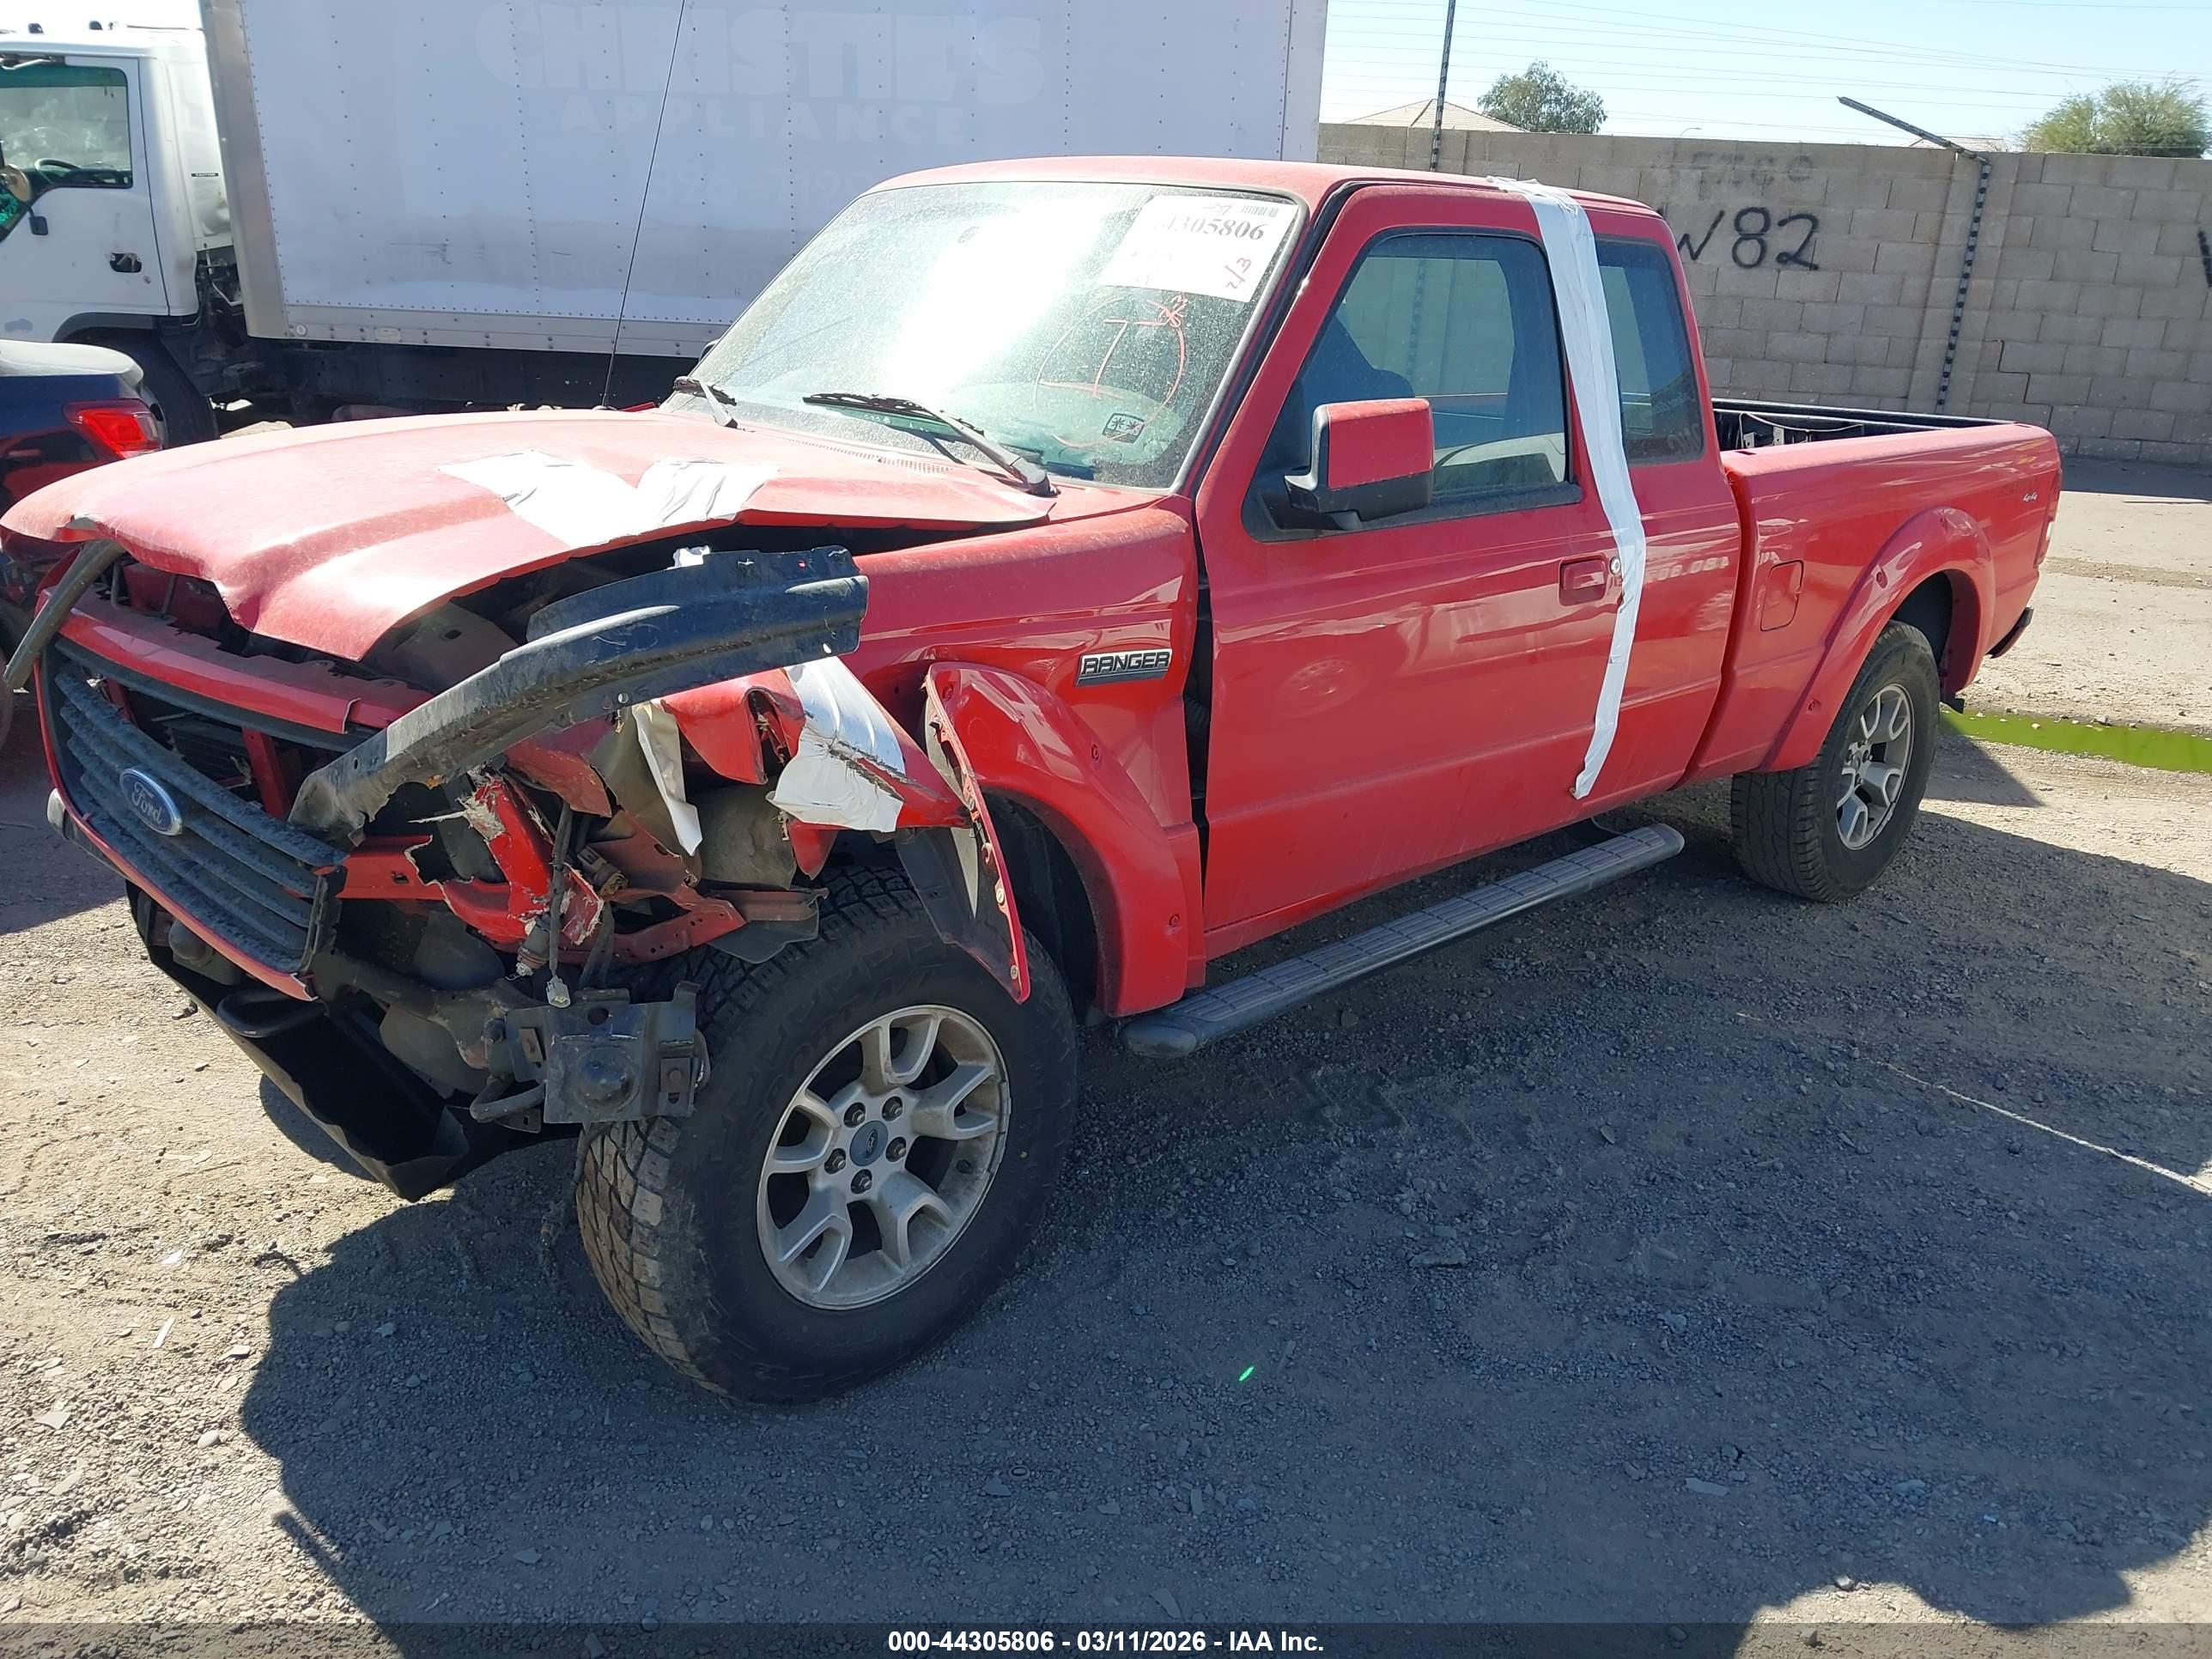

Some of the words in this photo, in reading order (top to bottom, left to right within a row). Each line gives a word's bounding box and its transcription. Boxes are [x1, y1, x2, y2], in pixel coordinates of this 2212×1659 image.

[560, 94, 964, 144] APPLIANCE
[1082, 651, 1170, 675] RANGER
[131, 781, 163, 824] Ford
